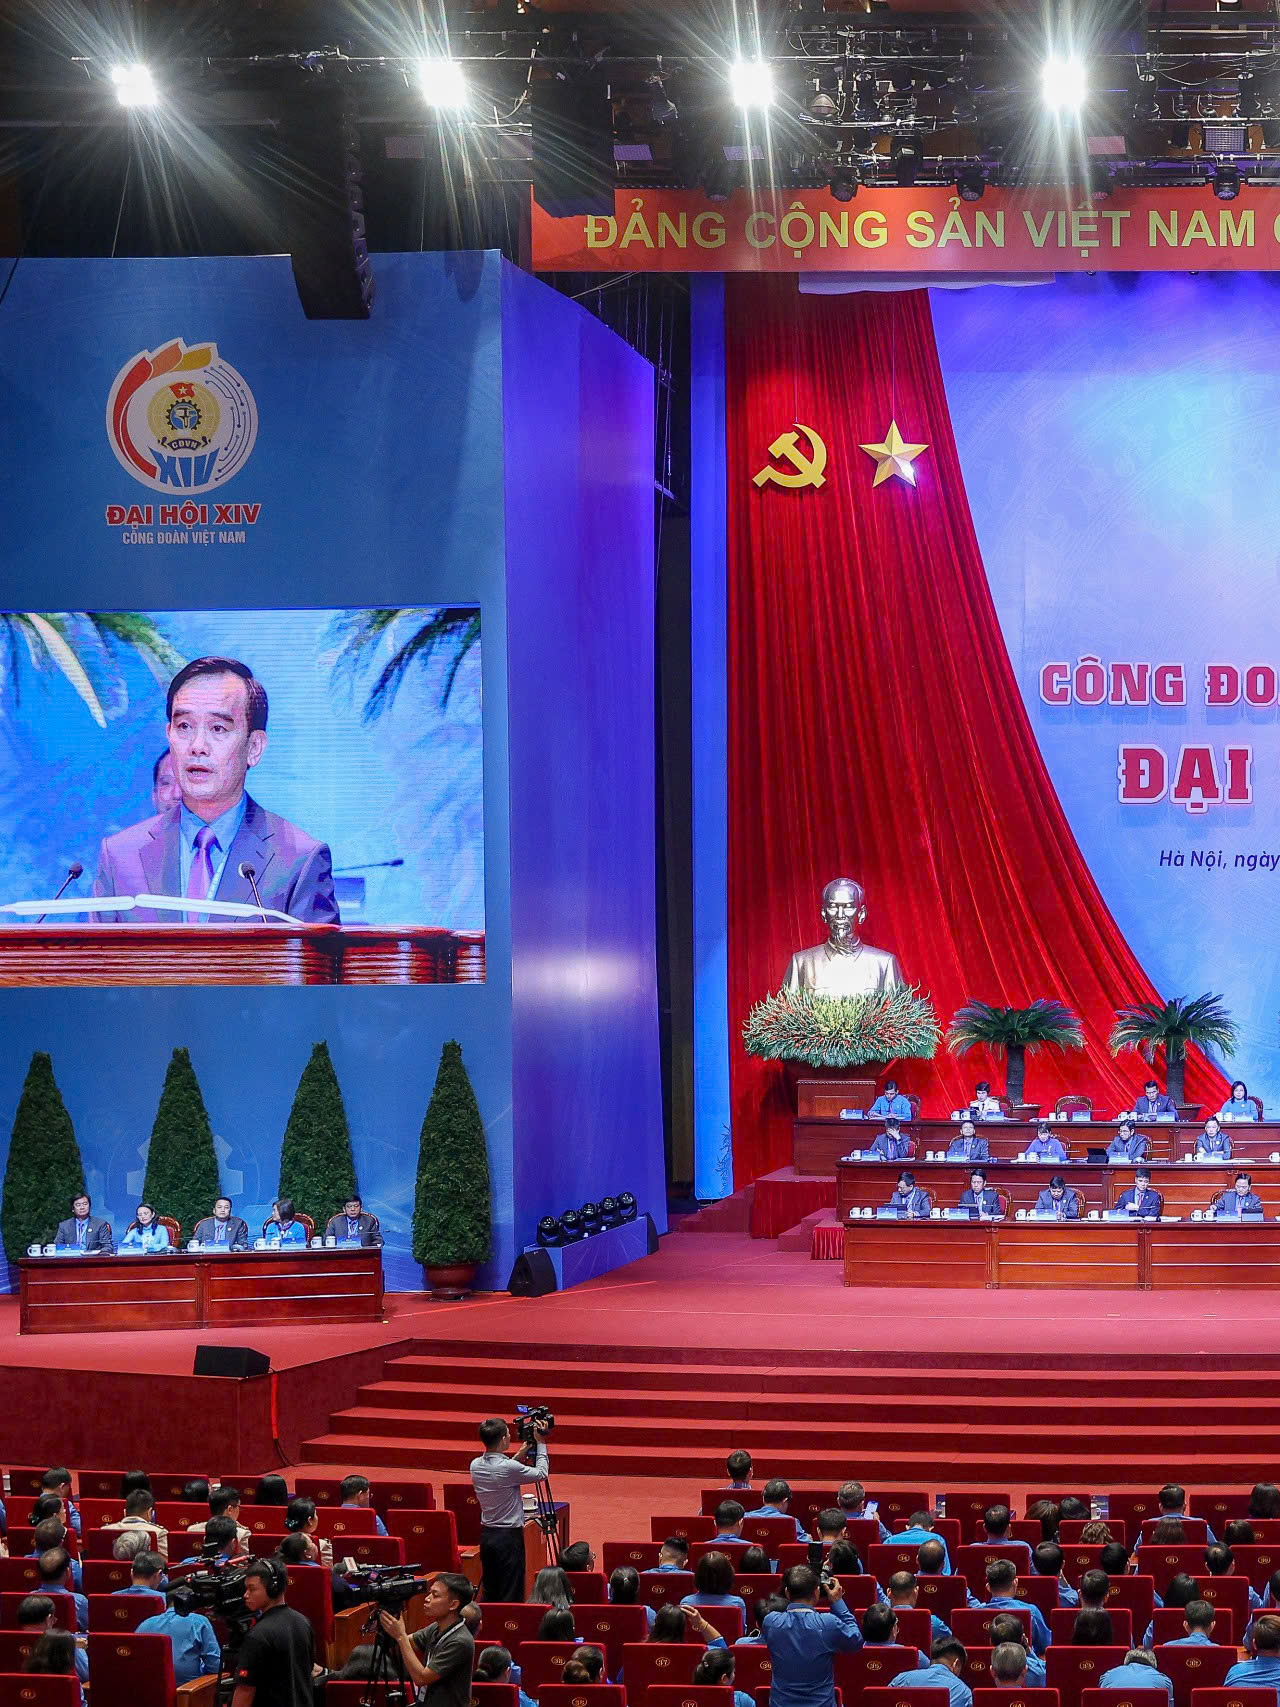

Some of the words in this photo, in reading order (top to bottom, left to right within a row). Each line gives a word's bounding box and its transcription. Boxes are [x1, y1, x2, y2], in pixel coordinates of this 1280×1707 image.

[584, 197, 726, 249] ĐẢNG
[745, 202, 889, 258] CỘNG
[905, 196, 1005, 249] SẢN
[1022, 202, 1130, 258] VIỆT
[1148, 211, 1256, 247] NAM
[148, 445, 220, 488] XIV
[106, 504, 153, 529] ĐẠI
[160, 500, 209, 529] HỘI
[213, 503, 262, 525] XIV
[122, 530, 154, 545] CÔNG
[157, 530, 189, 545] ĐOÀN
[192, 530, 216, 546] VIỆT
[219, 531, 246, 544] NAM
[1040, 654, 1188, 707] CÔNG
[1118, 744, 1253, 814] ĐẠI
[1159, 849, 1184, 867] Hà
[1190, 849, 1227, 872] Nội,
[1234, 850, 1280, 872] ngày
